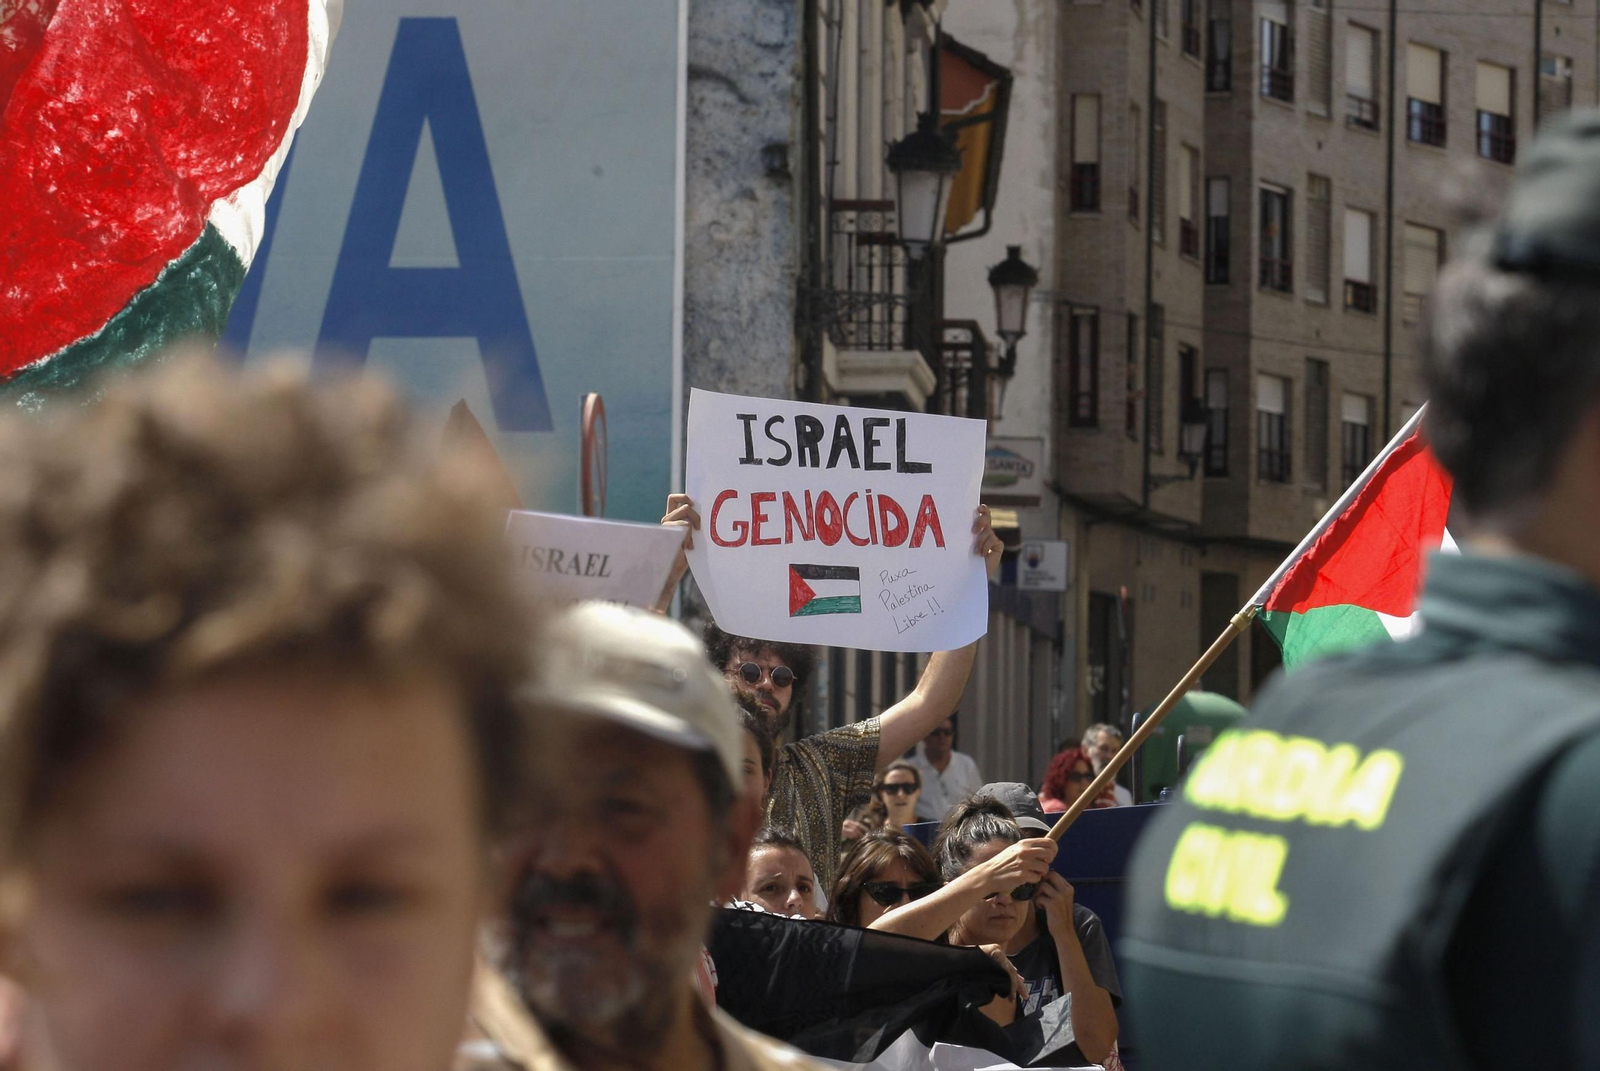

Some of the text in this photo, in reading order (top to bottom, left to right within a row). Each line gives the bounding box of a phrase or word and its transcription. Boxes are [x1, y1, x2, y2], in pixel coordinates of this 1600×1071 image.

[736, 413, 933, 474] ISRAEL
[519, 544, 613, 578] ISRAEL
[879, 568, 917, 586] Puxa
[878, 584, 935, 612] Palestina
